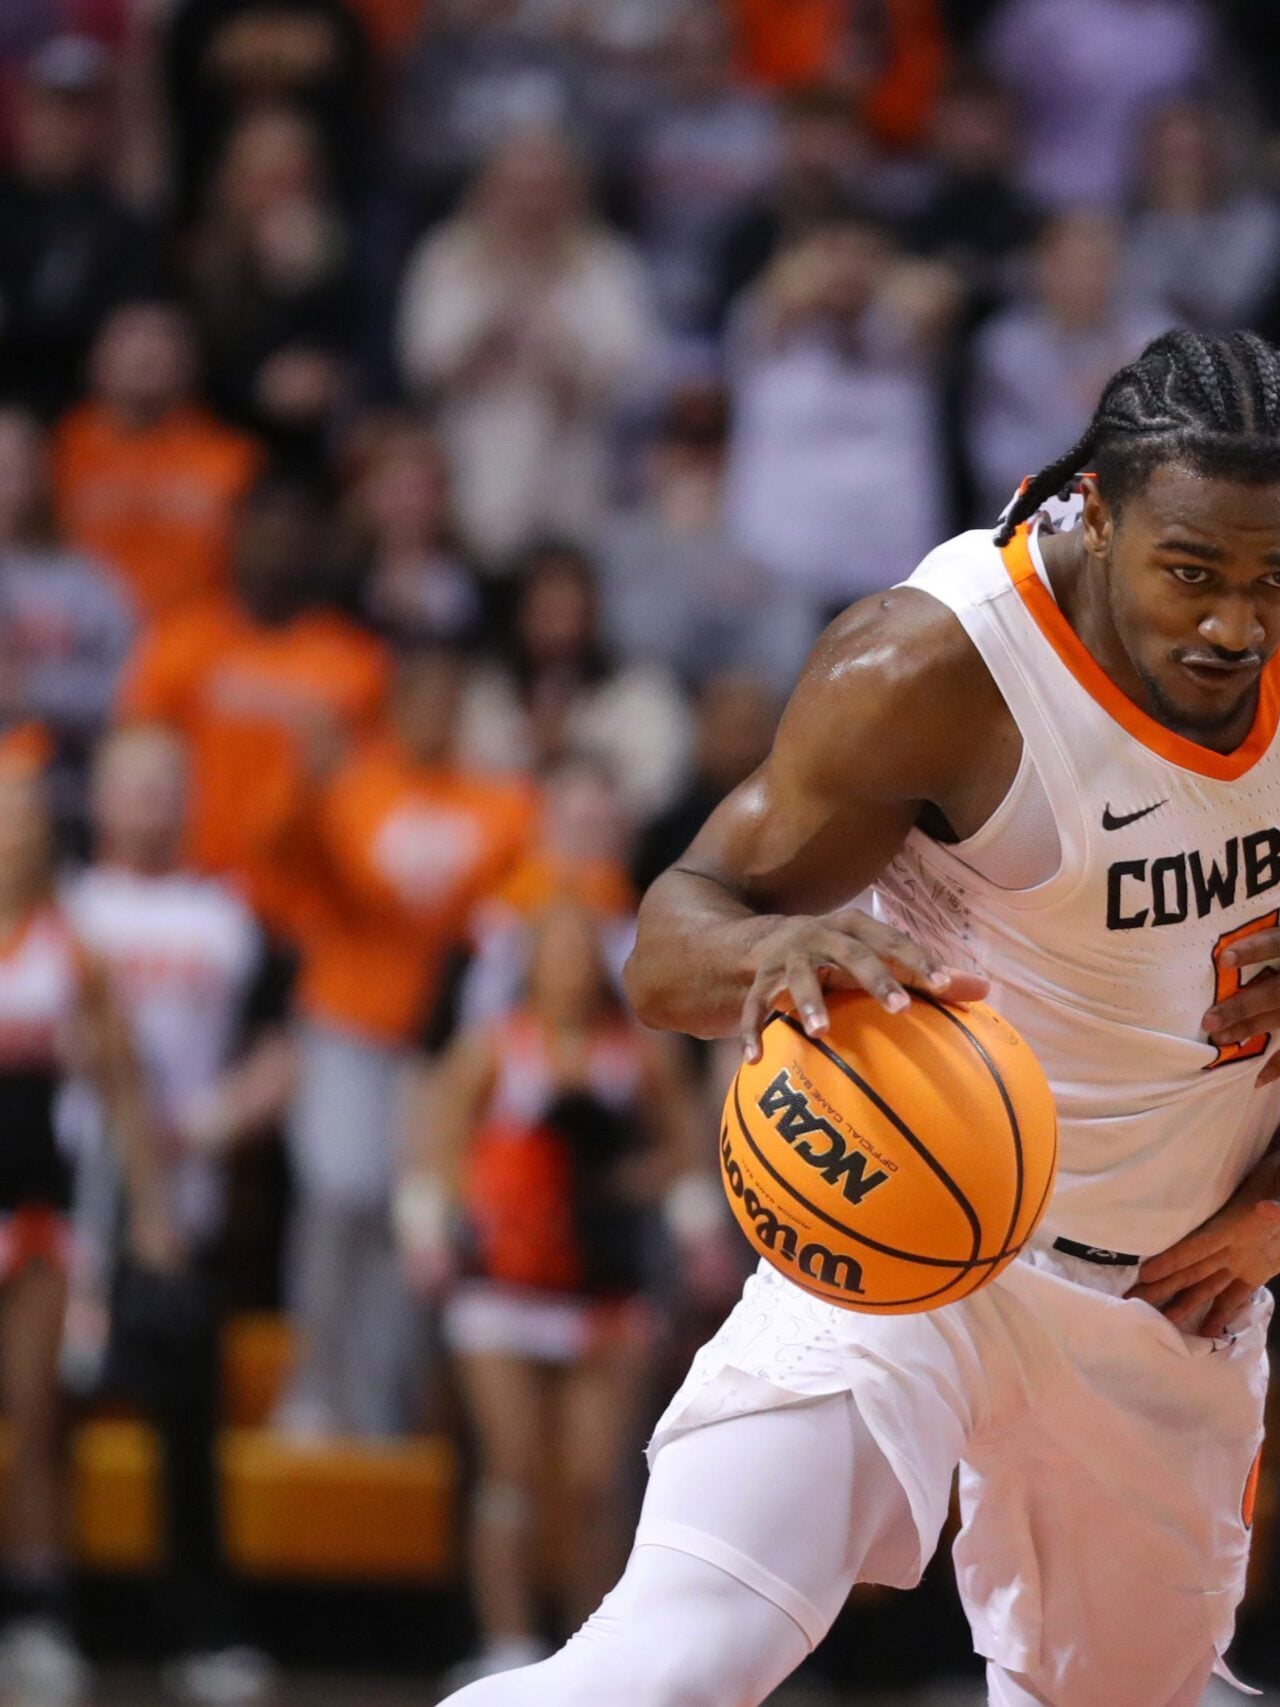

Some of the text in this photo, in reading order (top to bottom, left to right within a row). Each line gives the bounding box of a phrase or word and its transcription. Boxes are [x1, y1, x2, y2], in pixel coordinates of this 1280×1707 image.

[757, 1068, 889, 1206] NCAA
[791, 1059, 899, 1173] OFFICIAL GAME BALL
[721, 1114, 866, 1295] Wilson
